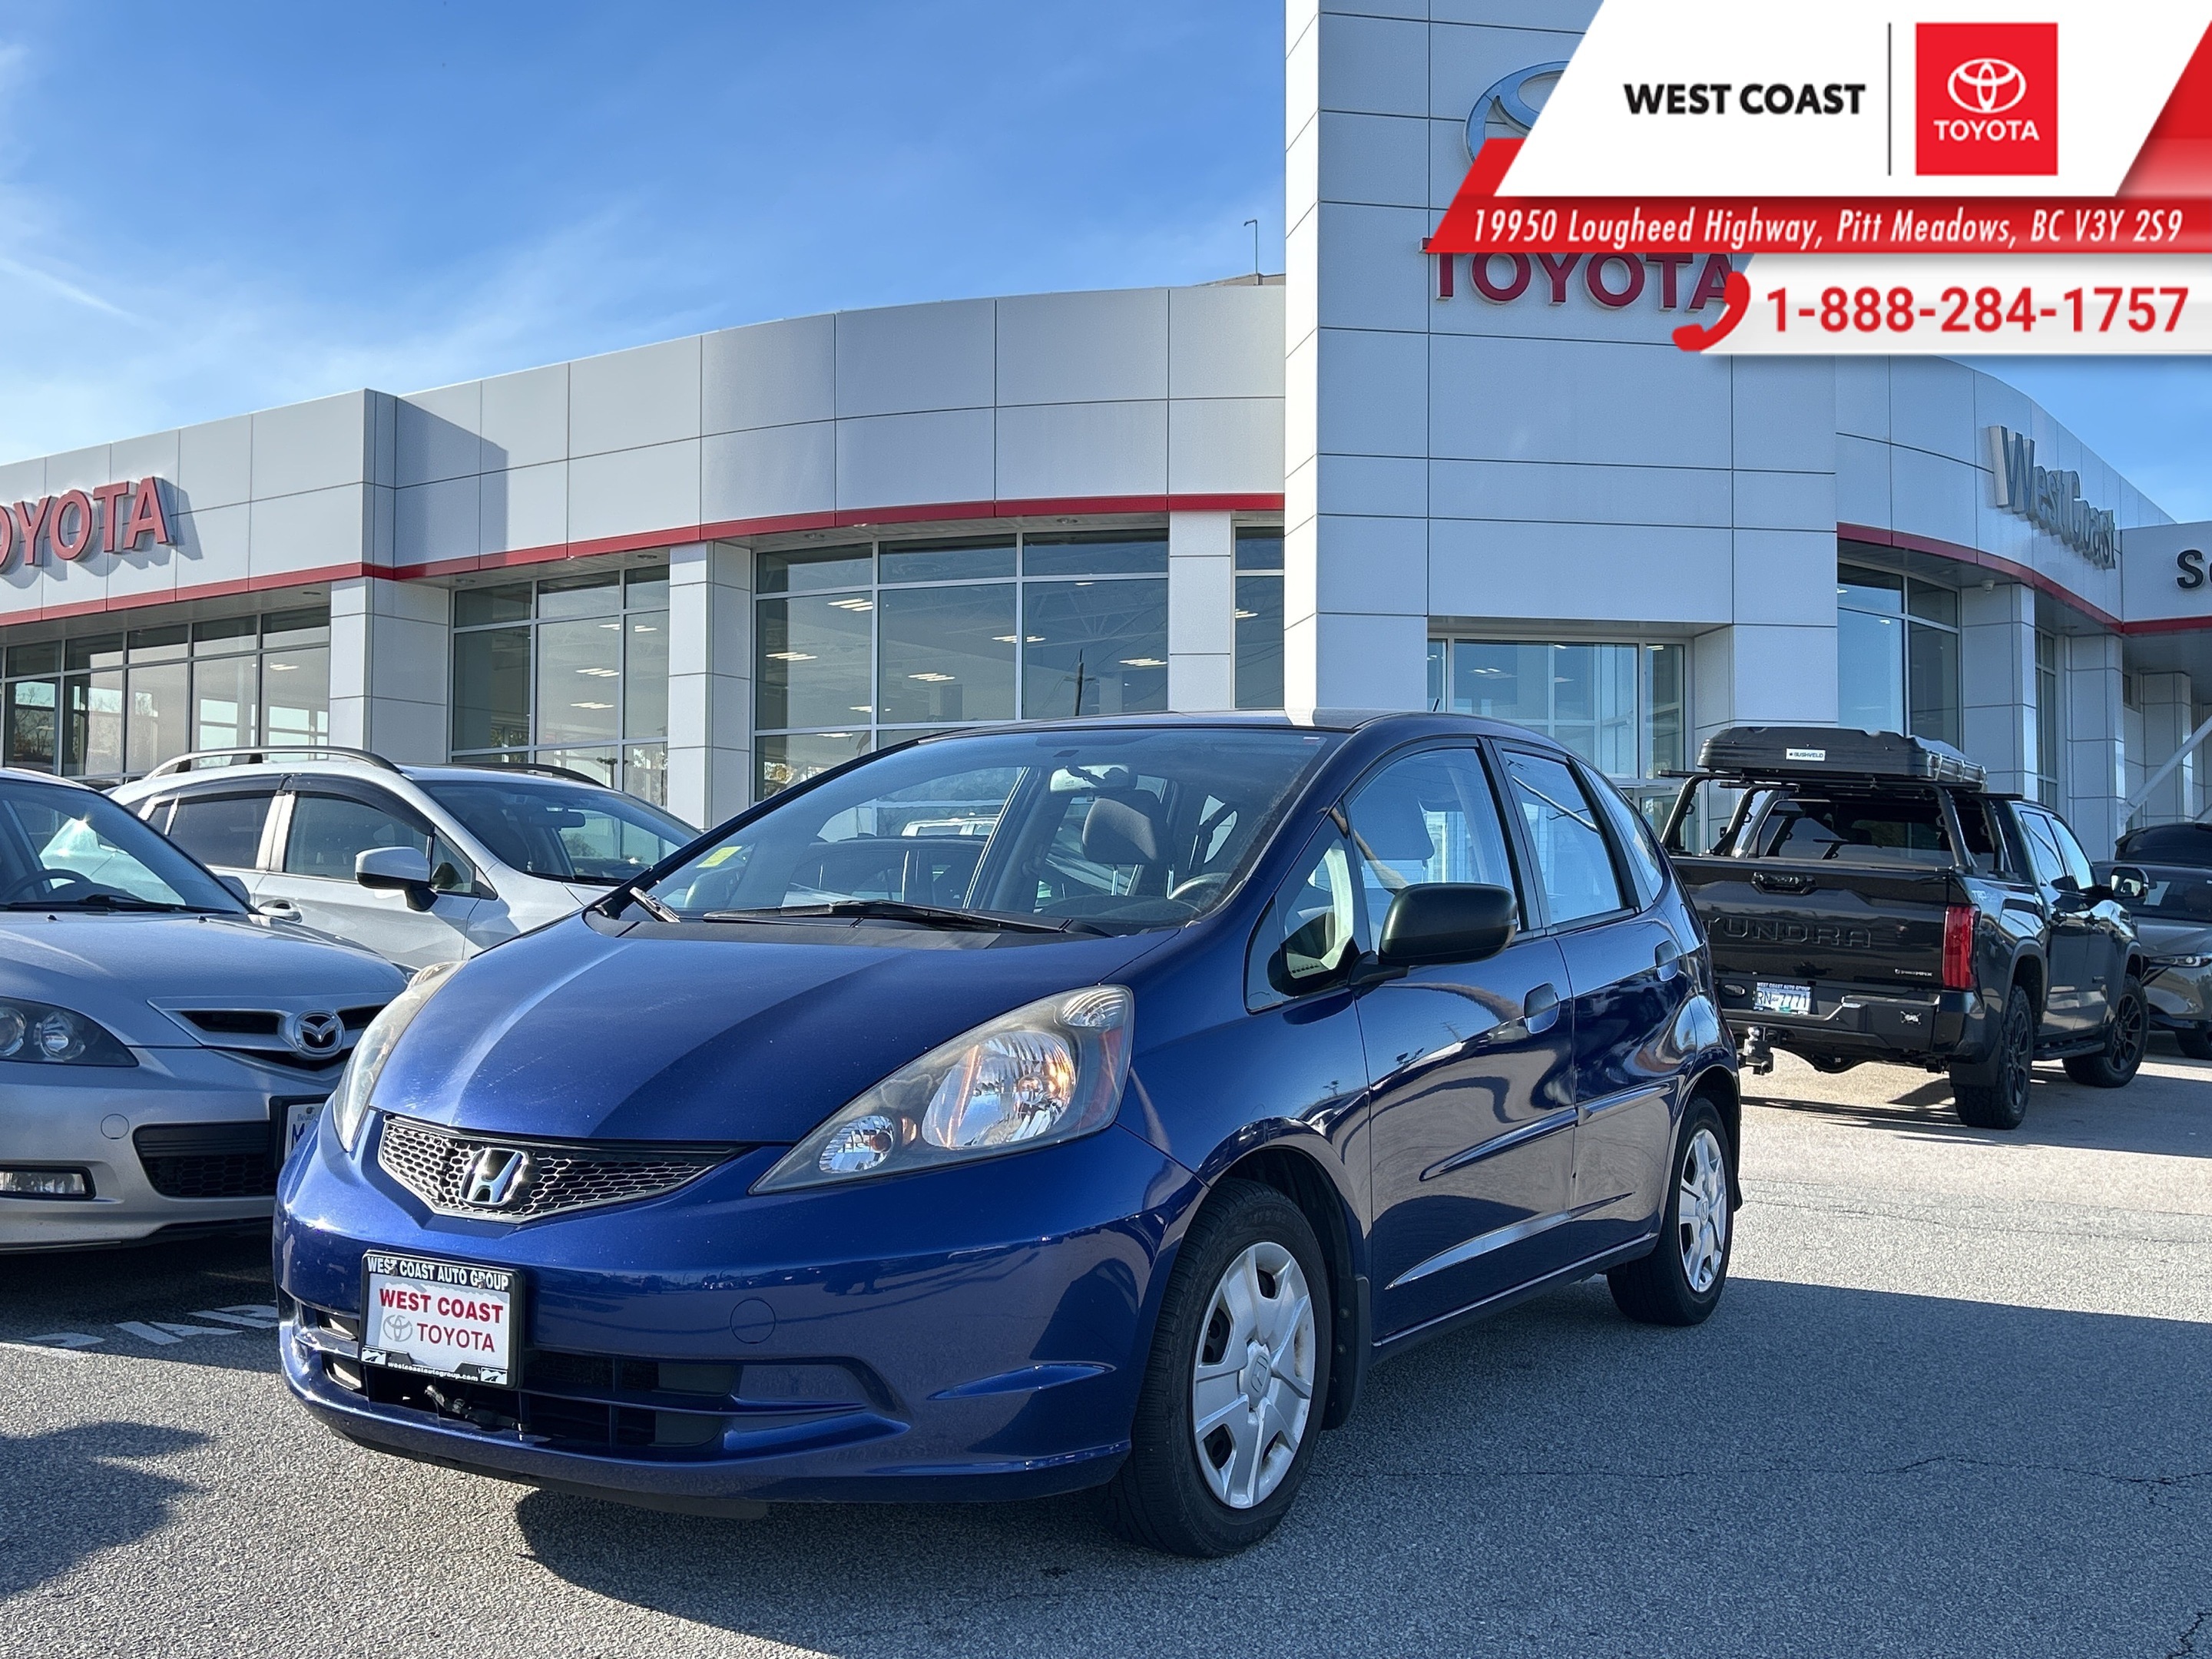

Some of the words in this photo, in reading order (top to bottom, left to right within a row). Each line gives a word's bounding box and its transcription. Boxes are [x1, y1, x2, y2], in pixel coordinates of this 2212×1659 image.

[1419, 237, 1733, 312] TOYOTA
[2176, 549, 2212, 589] S
[1703, 916, 1871, 949] TUNDRA
[399, 1260, 435, 1280] COAST
[437, 1266, 467, 1285] AUTO
[379, 1288, 432, 1313] WEST
[437, 1296, 504, 1323] COAST
[416, 1323, 495, 1353] TOYOTA
[387, 1362, 478, 1382] westcoastautogroup.com
